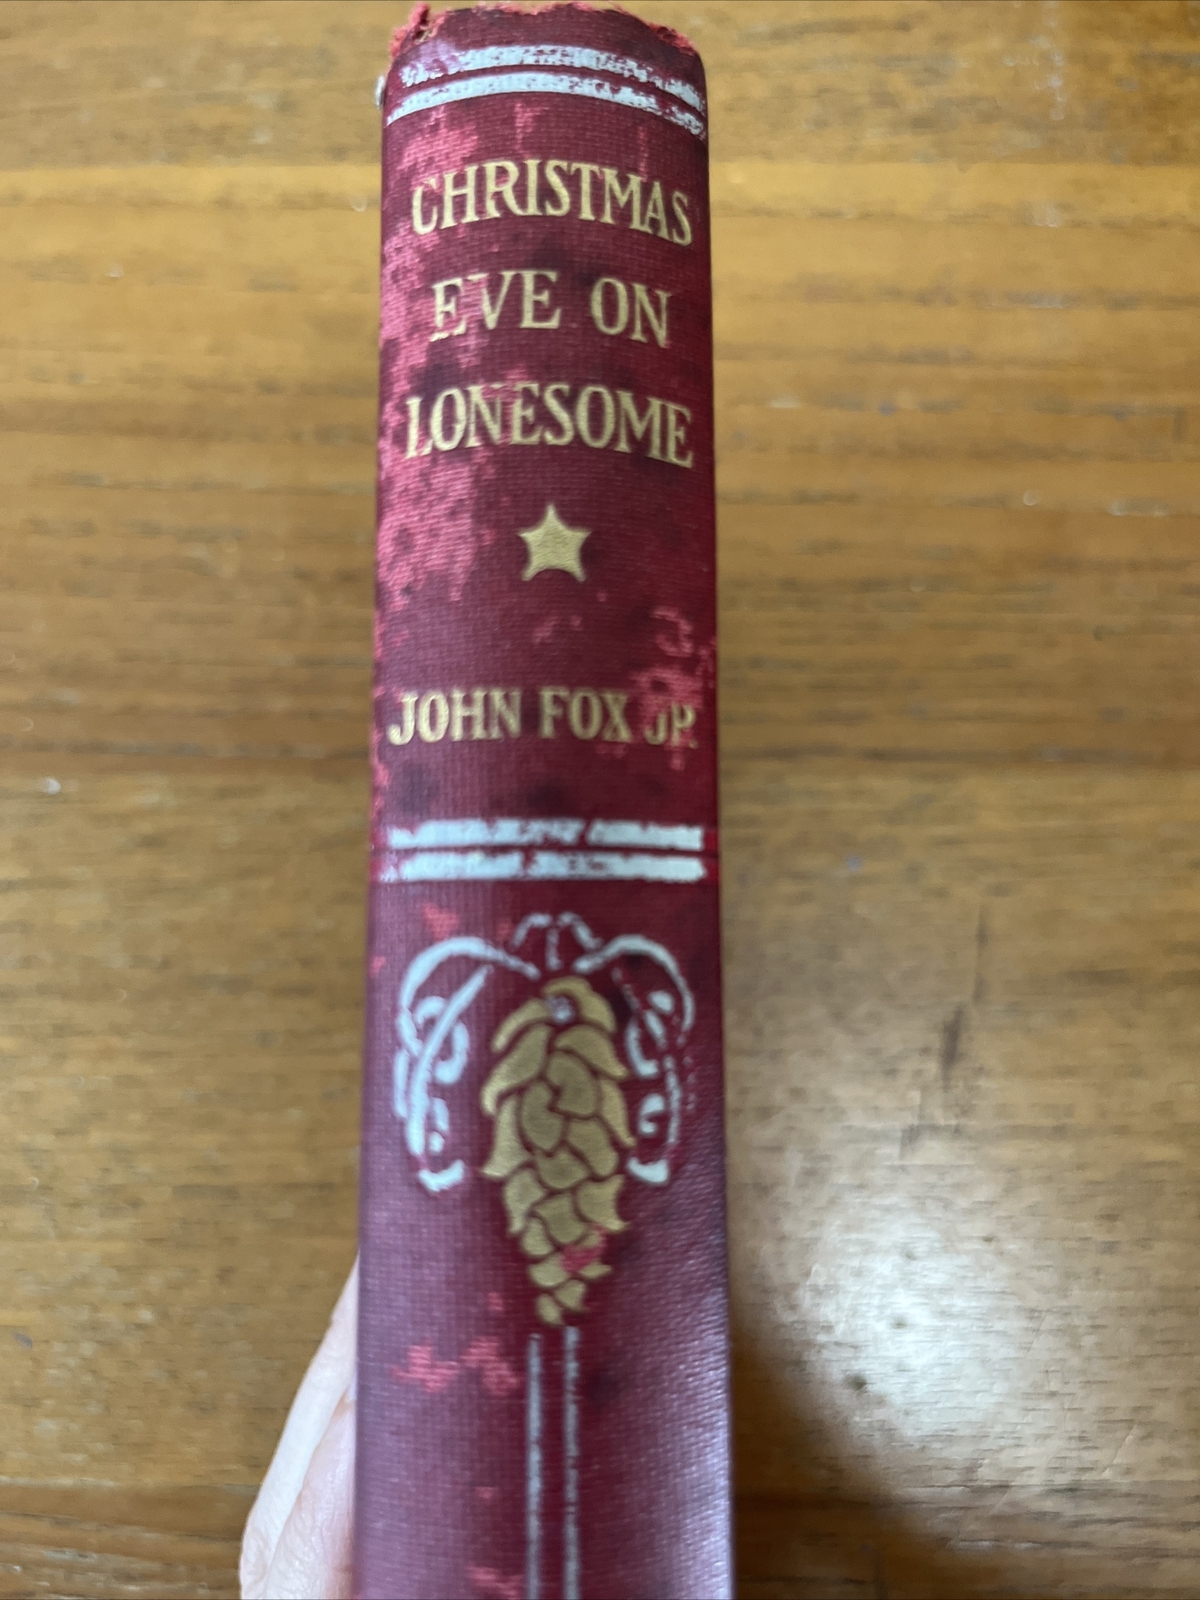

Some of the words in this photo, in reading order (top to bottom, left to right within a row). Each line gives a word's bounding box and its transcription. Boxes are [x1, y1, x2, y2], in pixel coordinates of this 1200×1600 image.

[412, 159, 692, 246] CHRISTMAS
[429, 269, 562, 342] EVE
[590, 277, 674, 348] ON
[403, 382, 693, 468] LONESOME
[387, 687, 523, 746] JOHN
[538, 687, 632, 744] FOX
